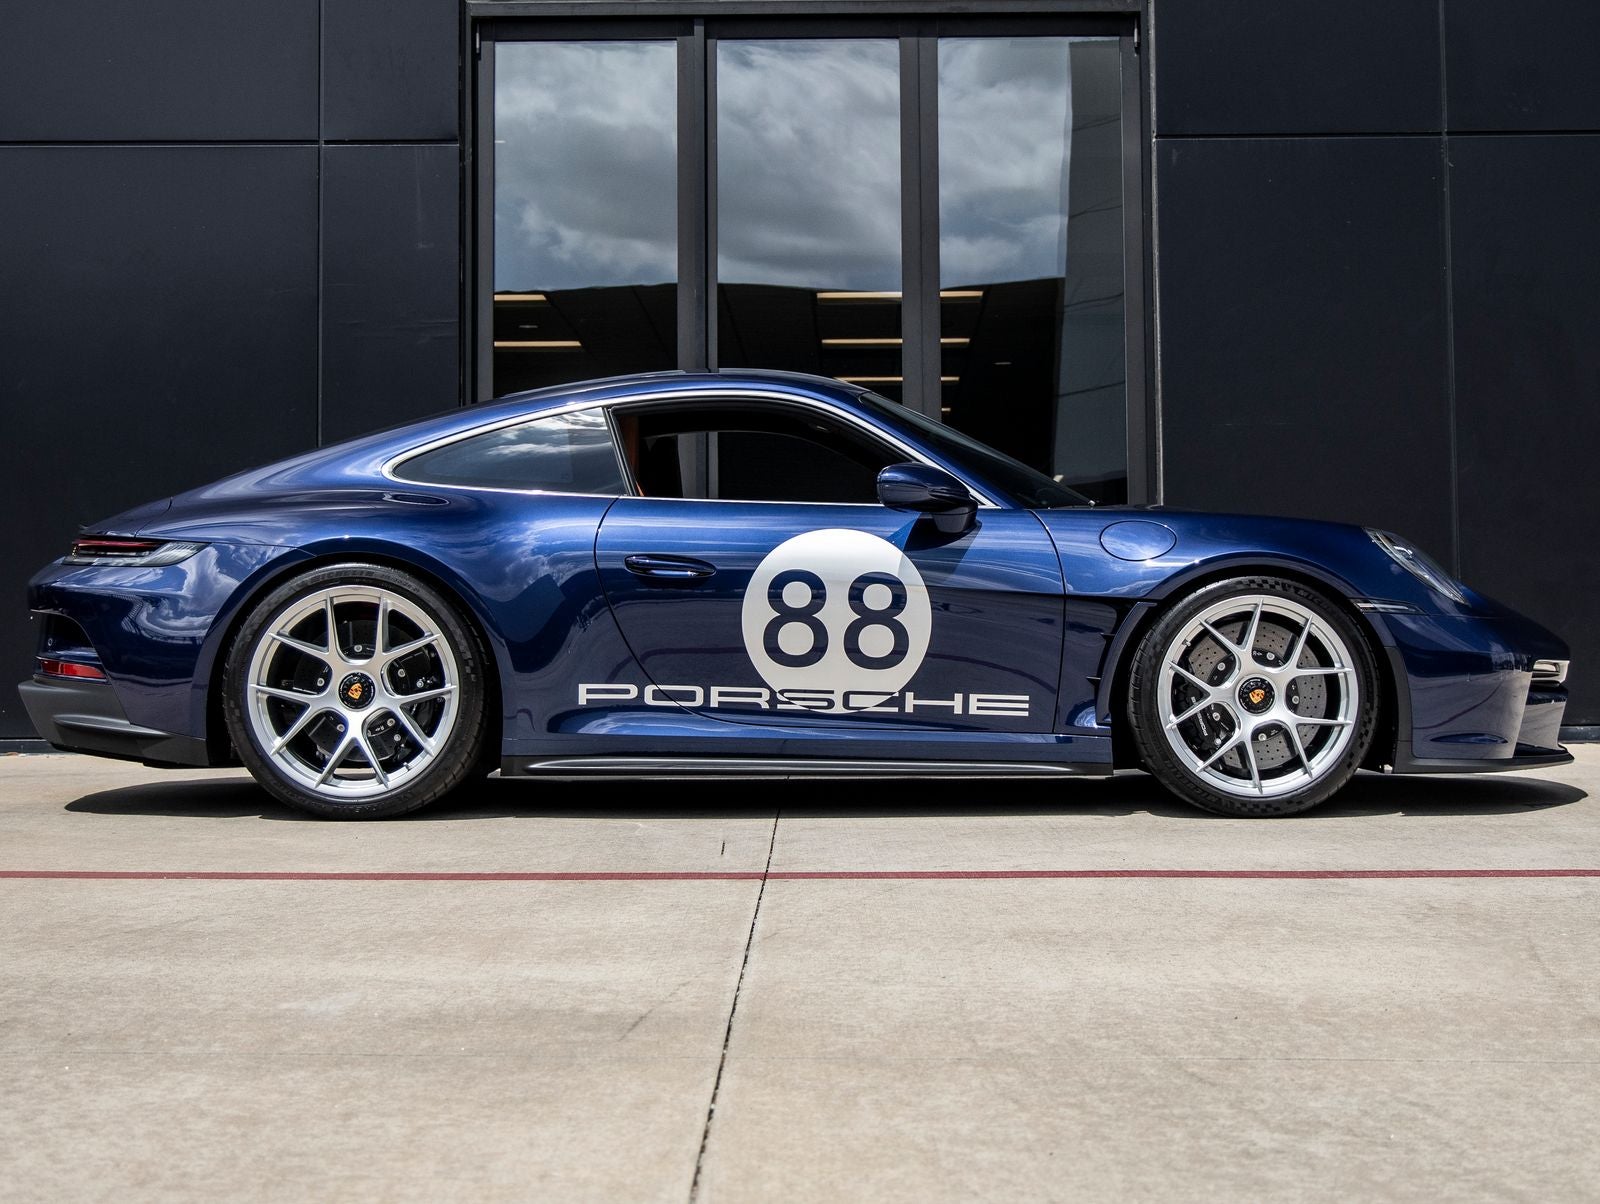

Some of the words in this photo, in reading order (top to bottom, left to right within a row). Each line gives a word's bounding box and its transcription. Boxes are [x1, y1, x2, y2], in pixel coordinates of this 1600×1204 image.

[311, 570, 375, 584] MICHELIN
[763, 569, 909, 670] 88
[578, 683, 1030, 716] PORSCHE
